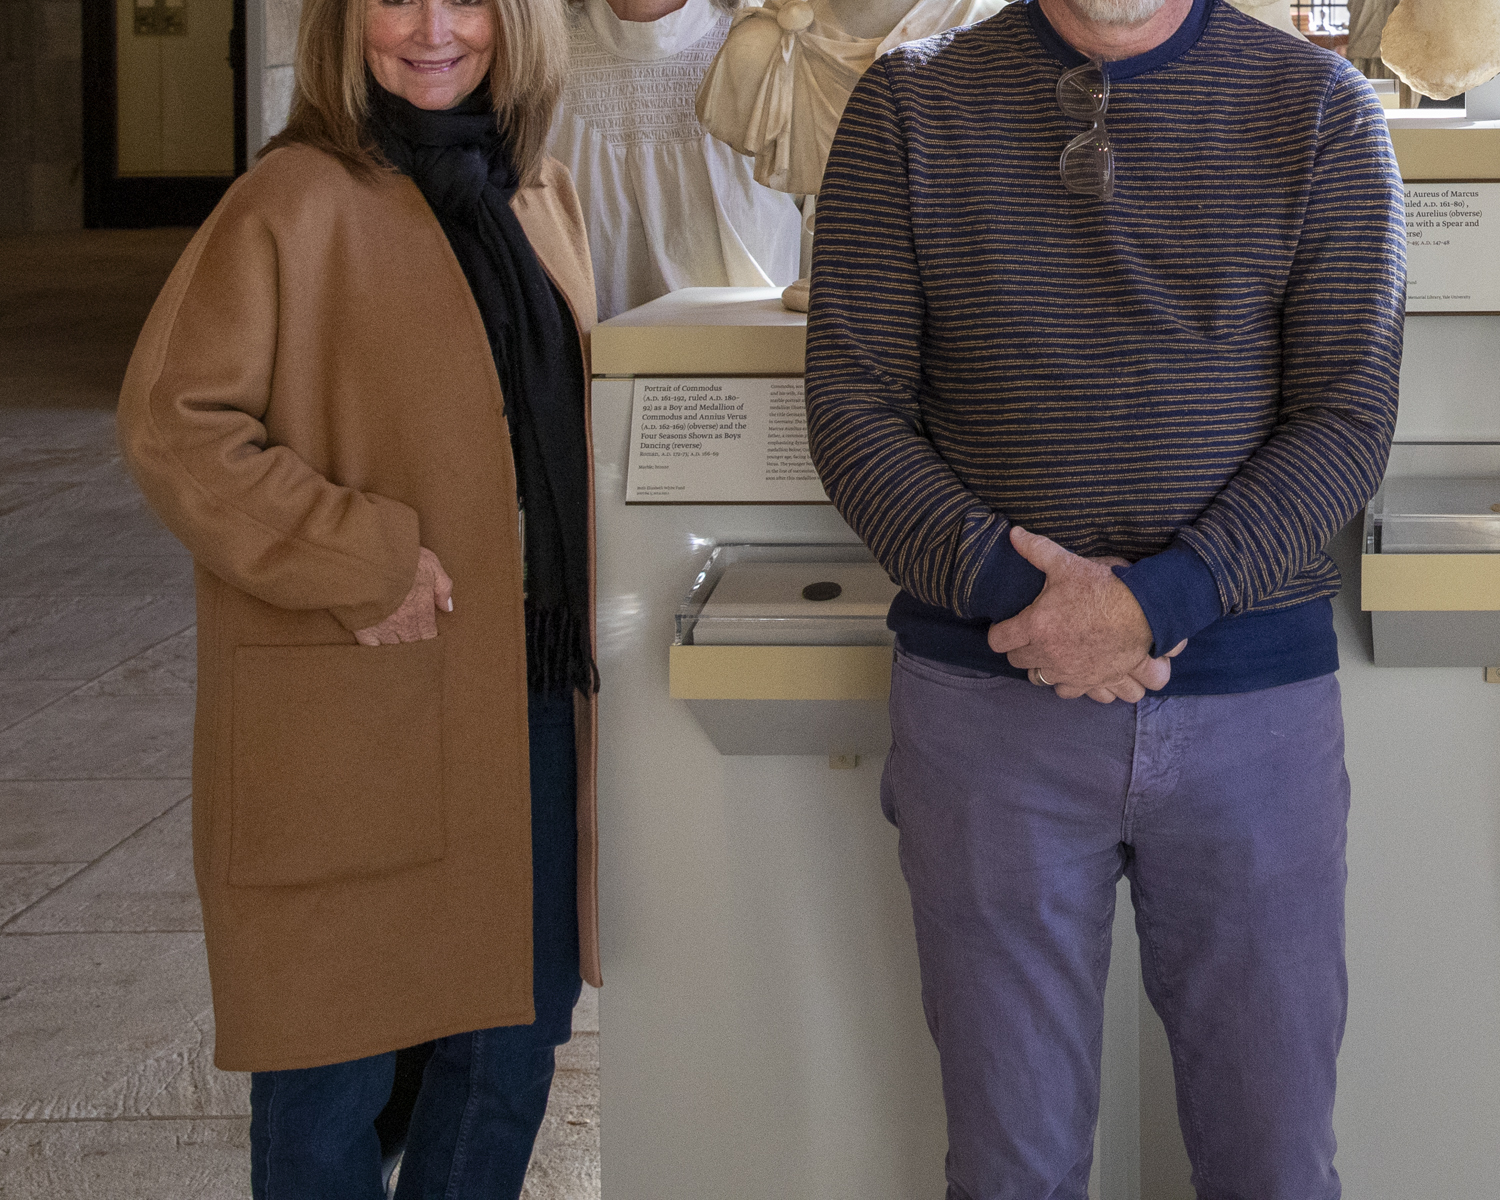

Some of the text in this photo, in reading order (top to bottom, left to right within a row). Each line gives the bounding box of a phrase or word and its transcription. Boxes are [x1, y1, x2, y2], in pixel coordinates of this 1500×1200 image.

[1449, 210, 1483, 218] (obverse)
[1442, 221, 1463, 229] Spear
[687, 422, 718, 430] (obverse)
[641, 442, 670, 451] Dancing
